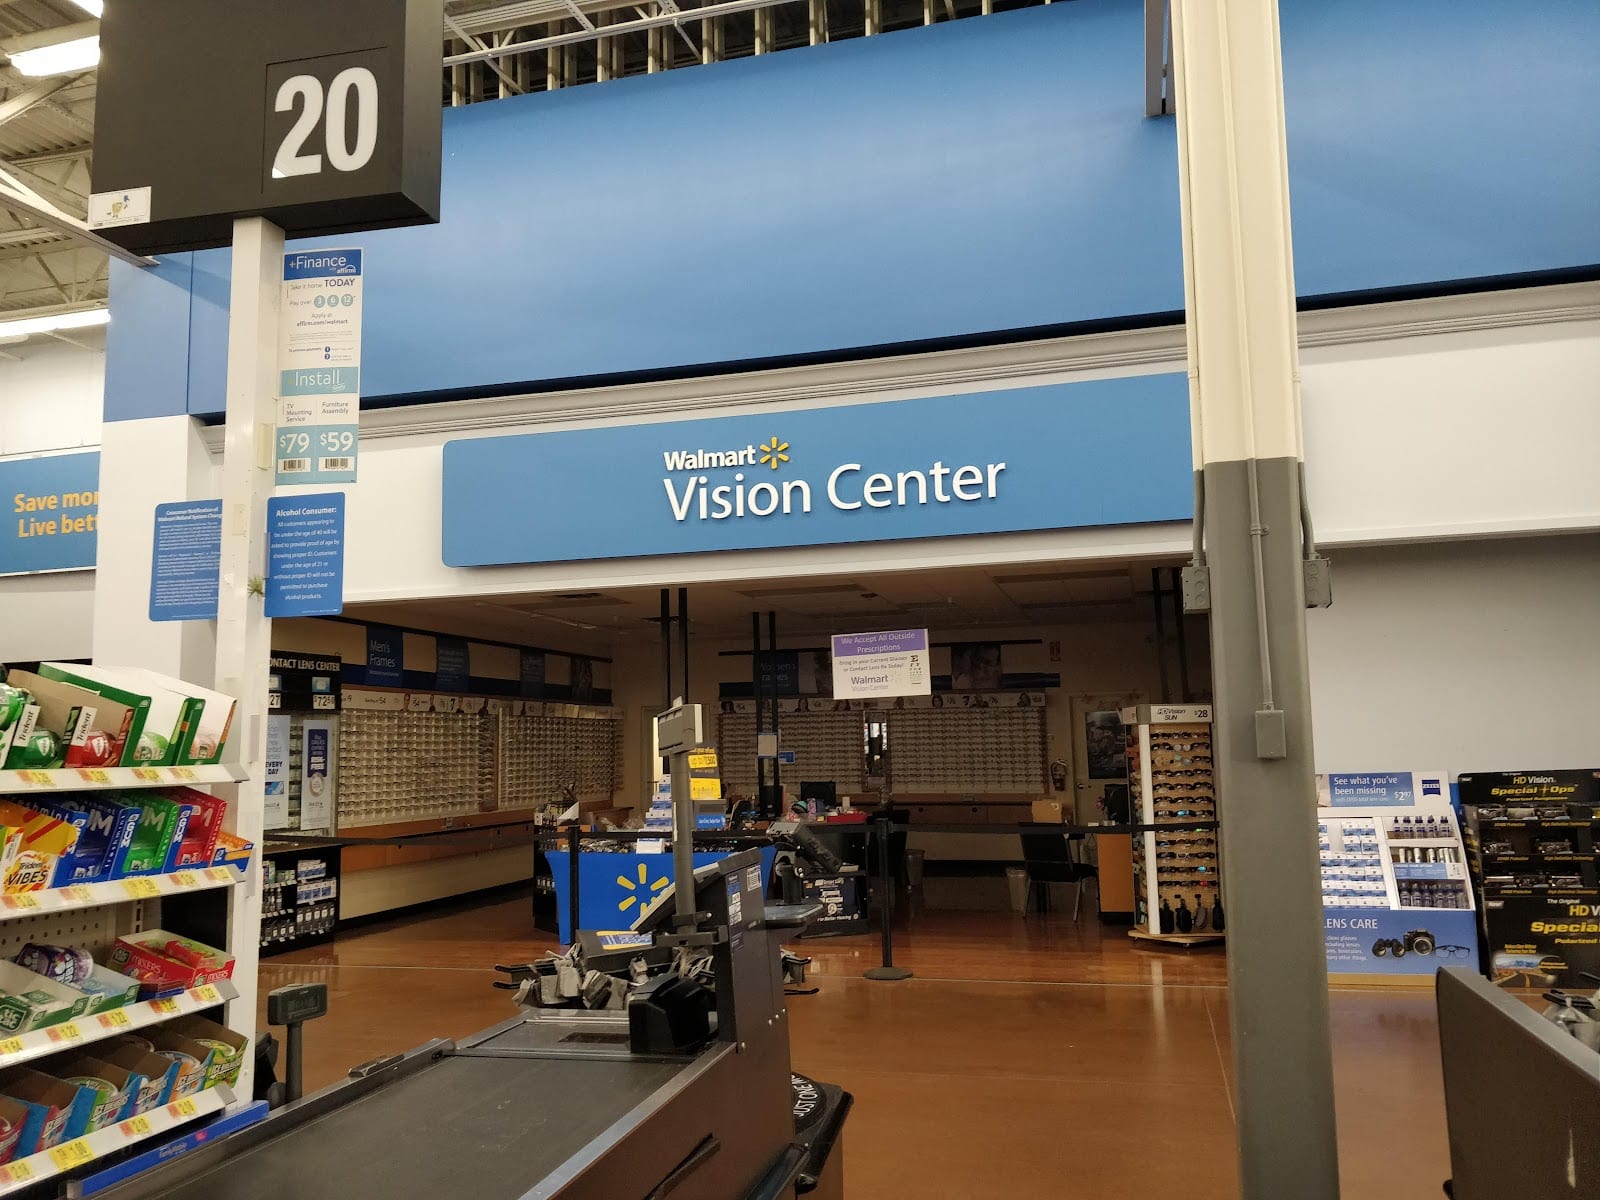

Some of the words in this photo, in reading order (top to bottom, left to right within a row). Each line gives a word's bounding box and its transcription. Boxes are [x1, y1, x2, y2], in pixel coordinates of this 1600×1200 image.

[272, 67, 378, 178] 20
[295, 369, 340, 387] Install
[280, 432, 310, 454] $79
[320, 431, 354, 452] $59
[664, 445, 756, 471] Walmart
[663, 473, 811, 521] Vision
[827, 461, 1006, 511] Center
[14, 493, 57, 513] Save
[276, 508, 301, 517] Alcohol
[302, 507, 337, 515] Consumer:
[18, 518, 56, 538] Live
[854, 636, 877, 644] Accept
[889, 632, 916, 641] Outside
[370, 640, 391, 654] Men's
[857, 645, 901, 653] Prescriptions
[298, 659, 315, 670] LENS
[315, 660, 340, 672] CENTER
[369, 653, 396, 668] Frames
[851, 674, 888, 685] Walmart
[1334, 777, 1348, 785] See
[1351, 776, 1370, 785] what
[1372, 775, 1398, 786] you've
[1513, 776, 1527, 784] HD
[1528, 775, 1554, 784] Vision
[1335, 787, 1354, 795] been
[1357, 786, 1386, 796] missing
[1491, 787, 1538, 796] Special
[1549, 786, 1575, 795] Ops
[8, 870, 49, 886] VIBES
[1569, 905, 1590, 916] HD
[1350, 918, 1378, 929] CARE
[132, 955, 162, 974] MIXERS
[793, 1084, 818, 1099] ONE
[793, 1099, 816, 1117] JUST
